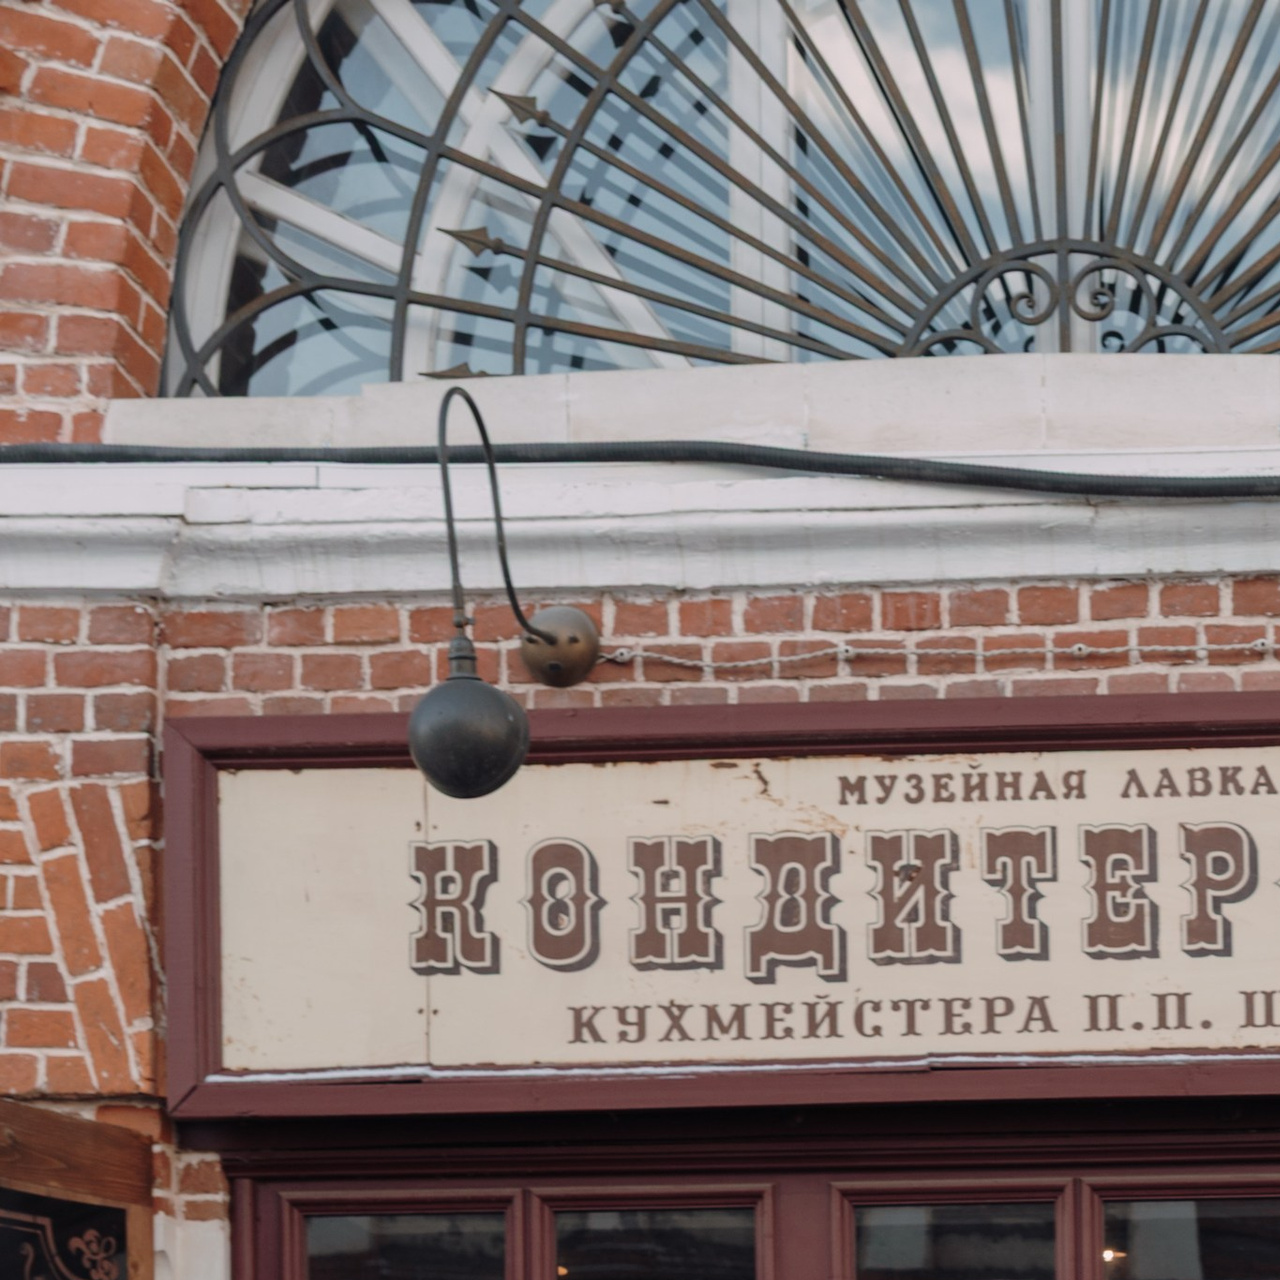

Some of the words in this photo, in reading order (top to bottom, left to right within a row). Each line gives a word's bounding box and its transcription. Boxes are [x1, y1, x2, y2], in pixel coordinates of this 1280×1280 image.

[838, 764, 1087, 807] МУЗЕЙНАЯ
[1119, 764, 1280, 800] ЛАВКА
[567, 993, 1059, 1045] КУХМЕЙСТЕРА
[1083, 991, 1213, 1034] П.П.
